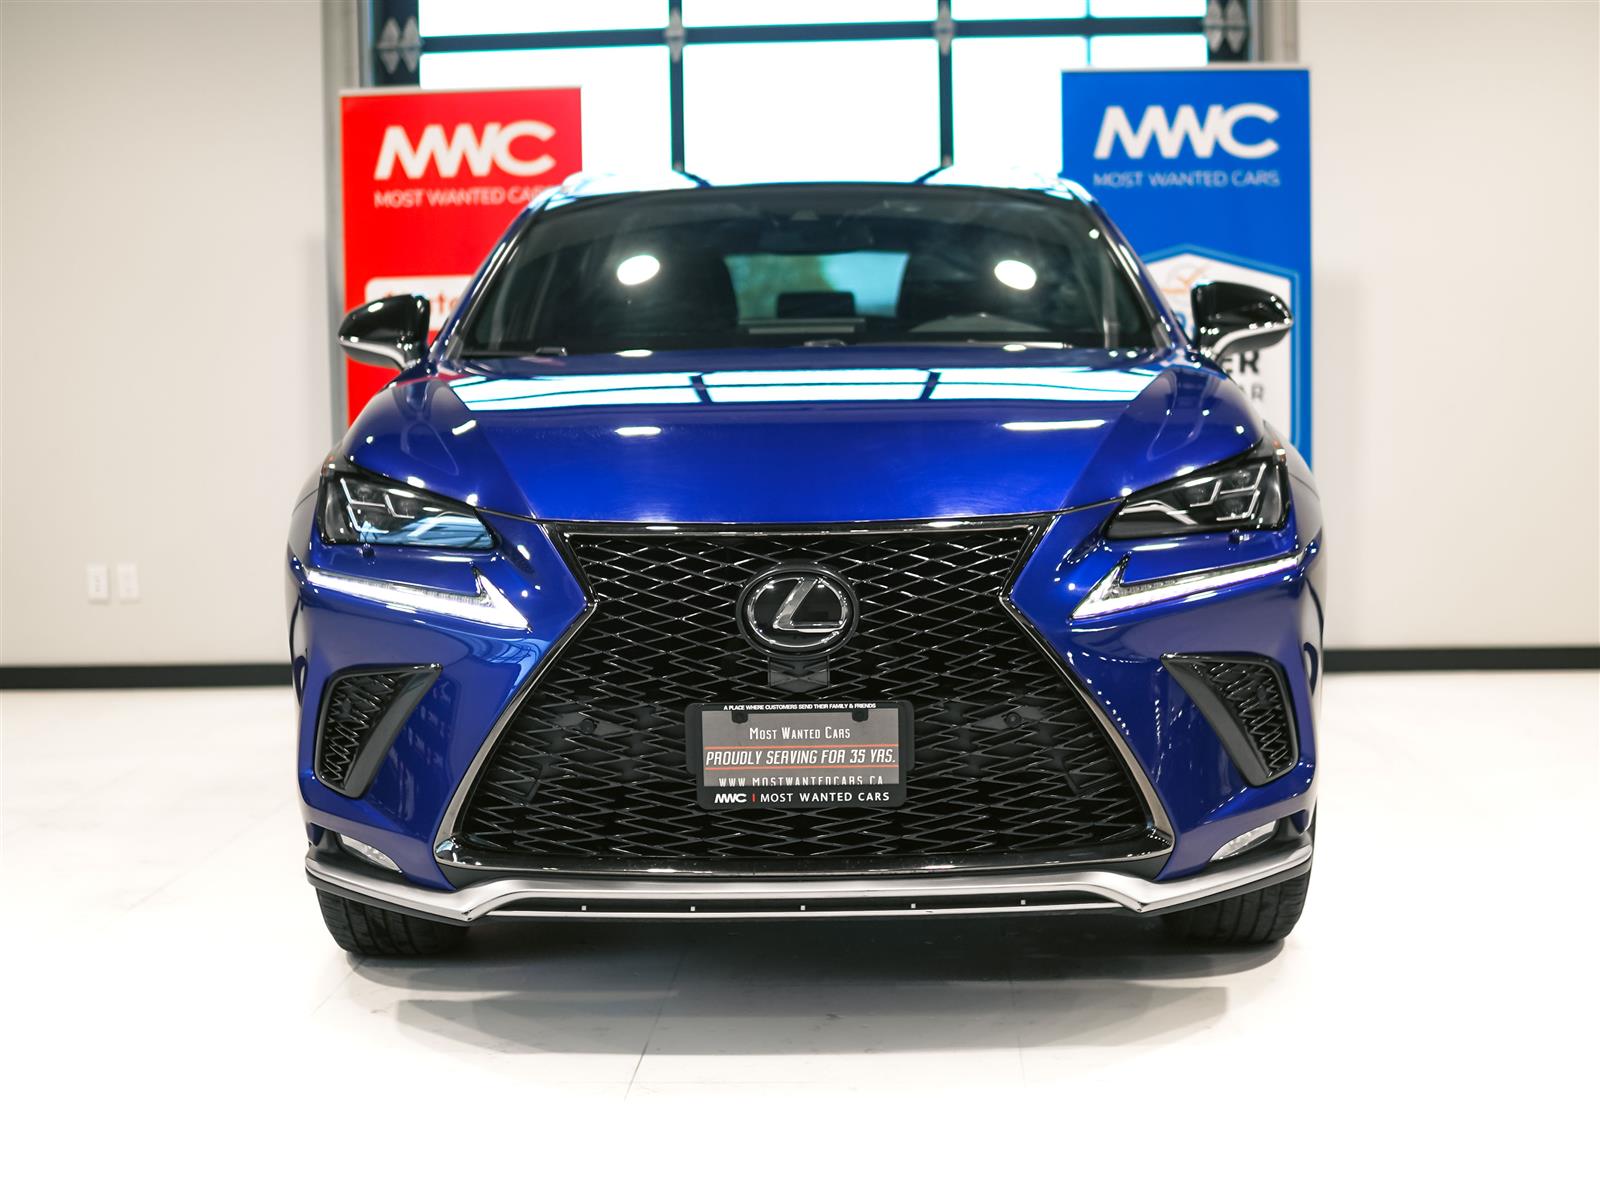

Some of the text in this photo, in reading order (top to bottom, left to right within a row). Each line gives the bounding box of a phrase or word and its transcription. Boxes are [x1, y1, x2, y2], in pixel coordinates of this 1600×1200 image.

[1093, 102, 1279, 159] MWC
[373, 120, 556, 180] MWC
[1093, 169, 1281, 188] MOST WANTED CARS
[373, 189, 424, 209] MOST
[427, 186, 505, 207] WANTED
[706, 748, 896, 766] PROUDLY SERVING FOR 35 YRS.
[714, 791, 890, 803] MWC MOST WANTED CARS
